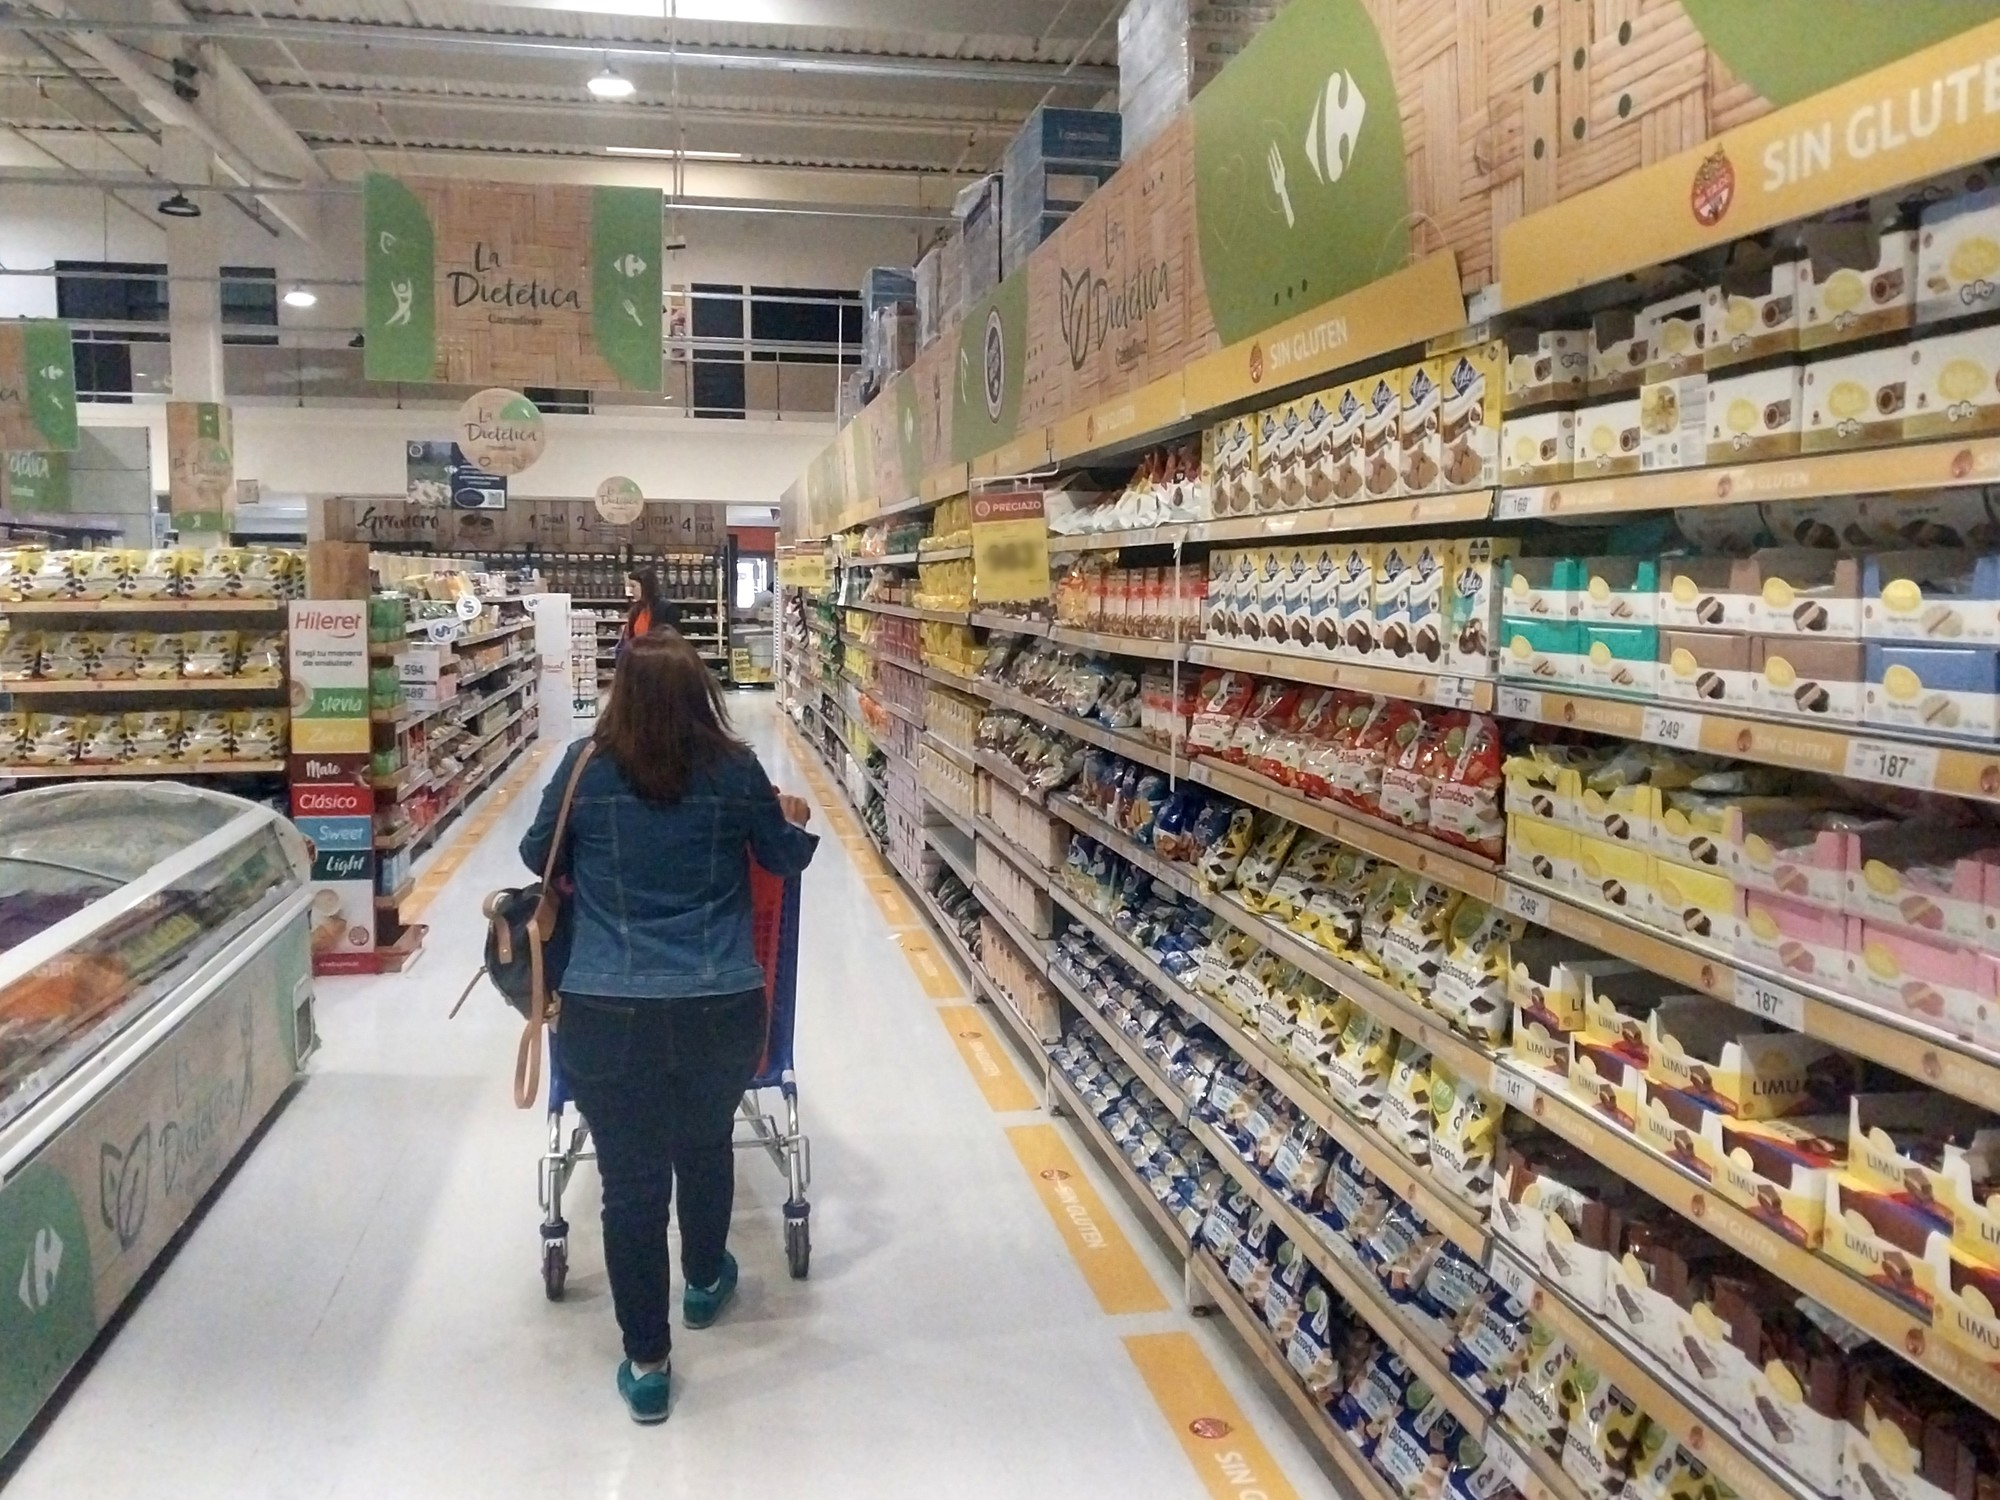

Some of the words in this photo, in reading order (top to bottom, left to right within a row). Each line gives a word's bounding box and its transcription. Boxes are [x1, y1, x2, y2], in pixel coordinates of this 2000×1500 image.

[1761, 121, 1832, 193] SIN
[474, 241, 501, 273] La
[446, 271, 581, 310] Dietética
[1093, 260, 1171, 351] Dietética
[1269, 340, 1294, 371] SIN
[1294, 316, 1349, 360] GLUTEN
[992, 500, 1042, 513] PRECIAZO
[294, 611, 362, 631] Hileret
[404, 664, 424, 676] 594
[1658, 719, 1681, 740] 249
[305, 759, 341, 779] Mate
[1878, 754, 1909, 779] 187
[299, 790, 358, 810] Clásico
[318, 825, 364, 842] Sweet
[325, 854, 365, 877] Light
[1519, 895, 1537, 916] 249
[1754, 989, 1779, 1015] 187
[1598, 1015, 1620, 1034] LIMU
[1526, 1040, 1552, 1059] LIMU
[1661, 1056, 1688, 1078] LIMU
[1507, 1079, 1521, 1099] 141
[1752, 1079, 1800, 1096] LIMU
[1648, 1117, 1673, 1142] LIMU
[1866, 1153, 1900, 1182] LIMU
[1727, 1169, 1756, 1197] LIMU
[1065, 1205, 1107, 1248] GLUTEN
[1981, 1222, 2000, 1245] LI
[1844, 1232, 1879, 1264] LIMU
[1433, 1256, 1485, 1295] Bizcochos
[1957, 1311, 2000, 1350] LIMU
[1388, 1426, 1426, 1474] Bizcochos
[1214, 1451, 1257, 1485] SIN
